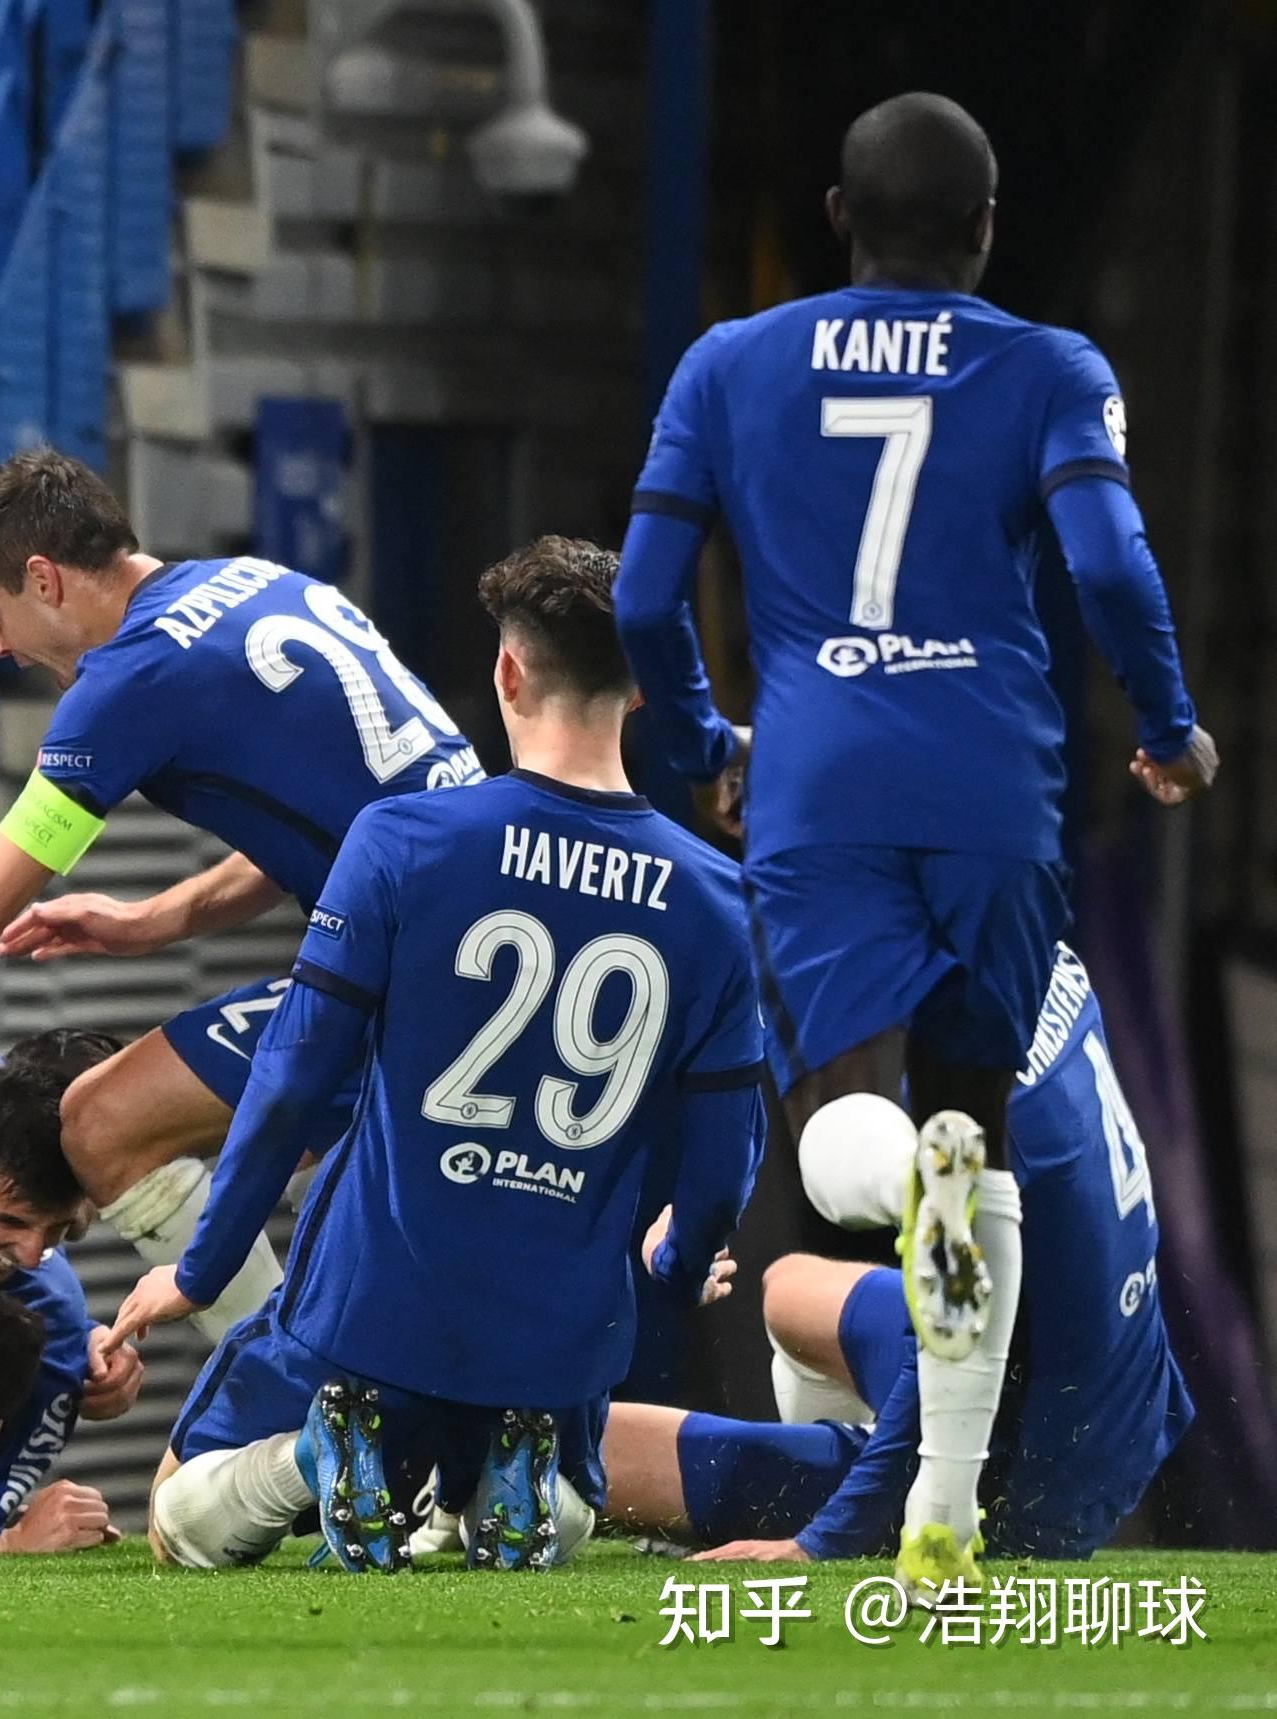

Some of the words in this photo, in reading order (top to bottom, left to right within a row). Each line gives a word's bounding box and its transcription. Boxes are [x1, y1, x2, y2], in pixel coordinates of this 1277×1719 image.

[811, 311, 953, 376] KANTÉ
[820, 395, 933, 631] 7
[245, 584, 460, 784] 28
[42, 752, 94, 769] RESPECT
[500, 825, 673, 911] HAVERTZ
[309, 908, 345, 932] SPECT
[421, 909, 670, 1150] 29
[1082, 1028, 1157, 1228] 4
[491, 1177, 577, 1204] INTERNATIONAL
[494, 1150, 586, 1194] PLAN
